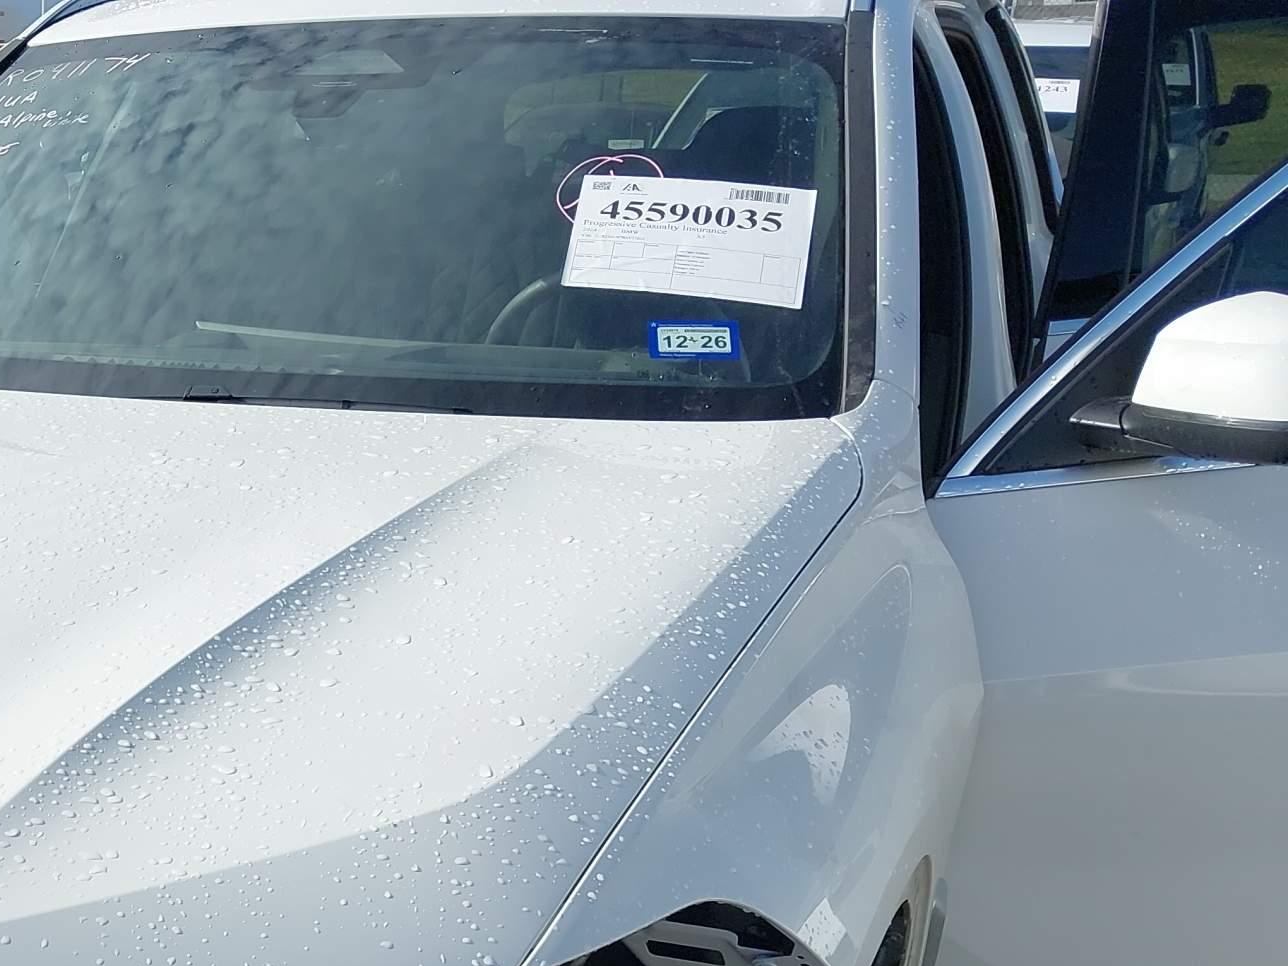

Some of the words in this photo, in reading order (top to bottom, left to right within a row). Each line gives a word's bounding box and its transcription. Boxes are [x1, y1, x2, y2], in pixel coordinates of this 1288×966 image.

[600, 199, 784, 232] 45590035
[583, 219, 638, 229] Progressive
[639, 222, 680, 232] Casualty
[683, 225, 728, 235] Insurance
[663, 335, 689, 349] 12
[700, 335, 727, 349] 26
